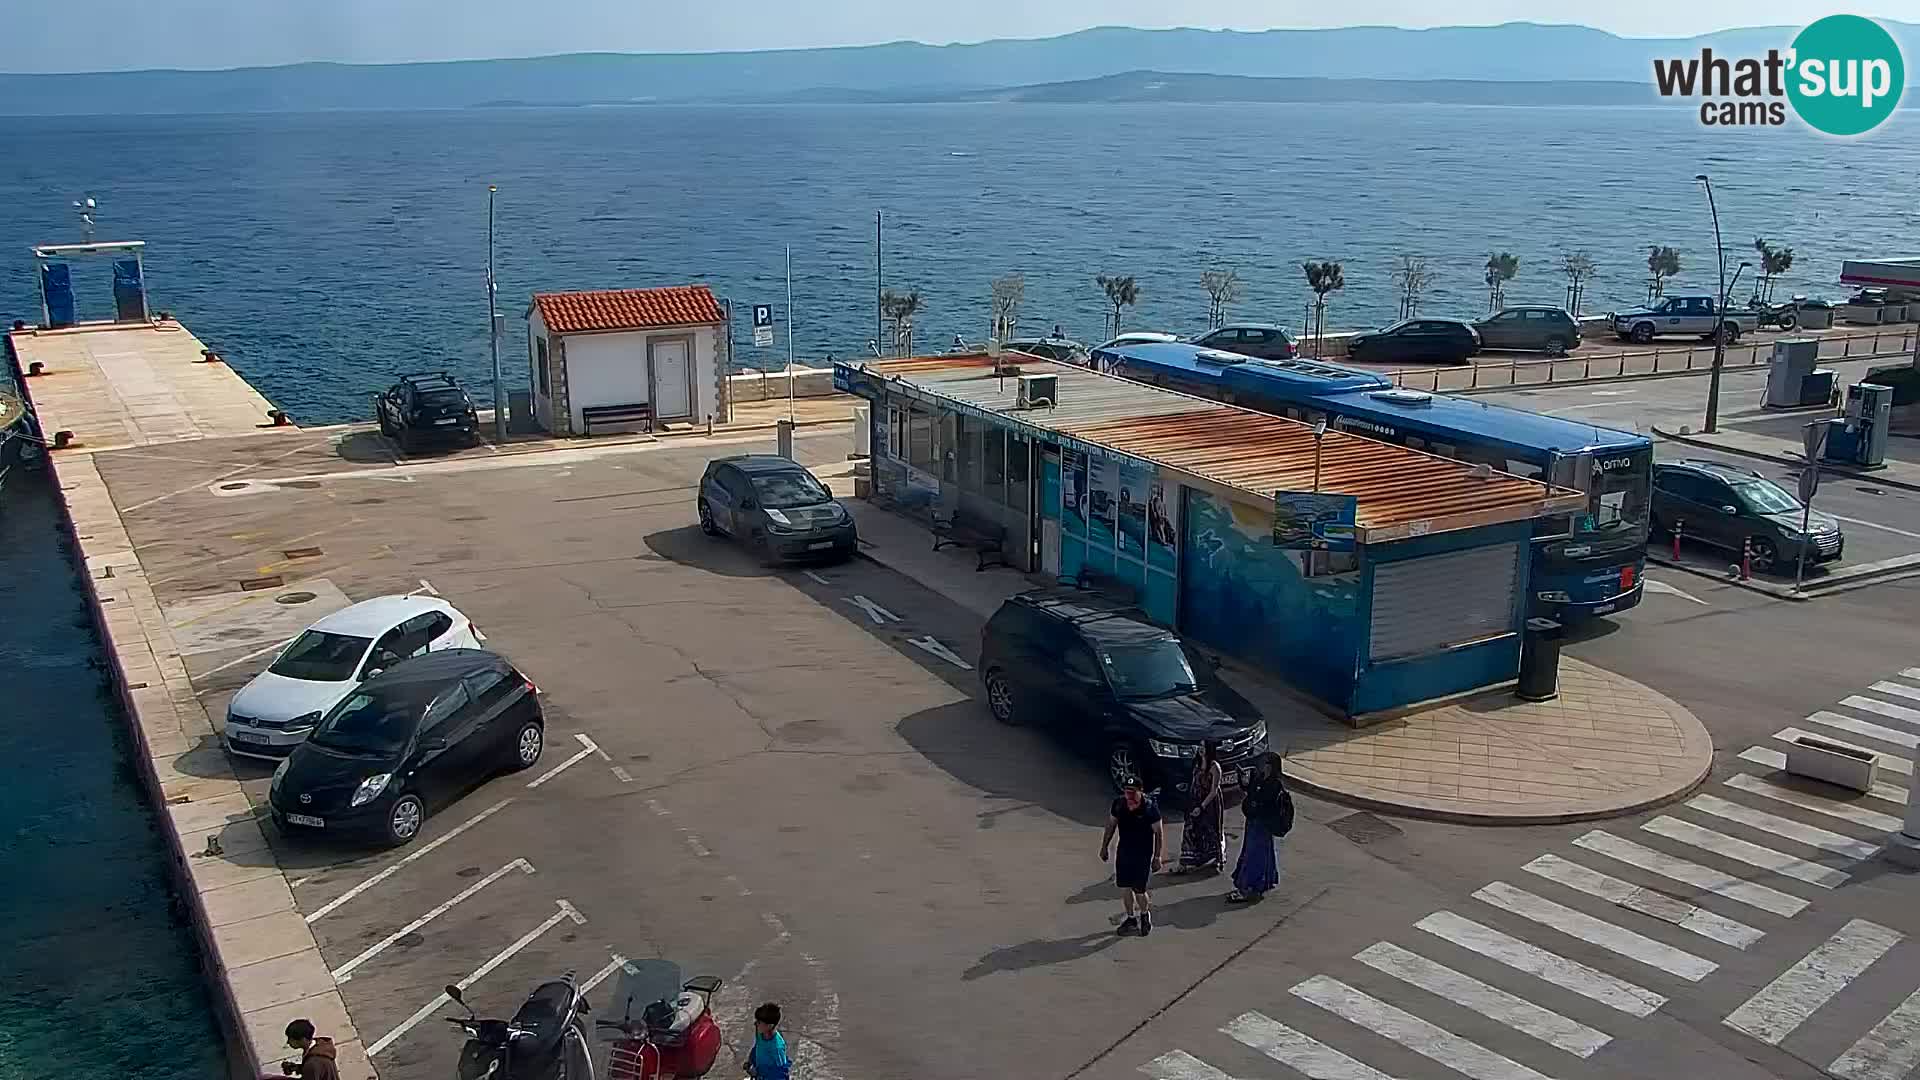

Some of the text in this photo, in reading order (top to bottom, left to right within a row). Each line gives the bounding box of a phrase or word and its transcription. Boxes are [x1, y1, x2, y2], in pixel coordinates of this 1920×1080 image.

[757, 307, 768, 325] P
[1057, 435, 1156, 473] BUS STATION TICKET OFFICE
